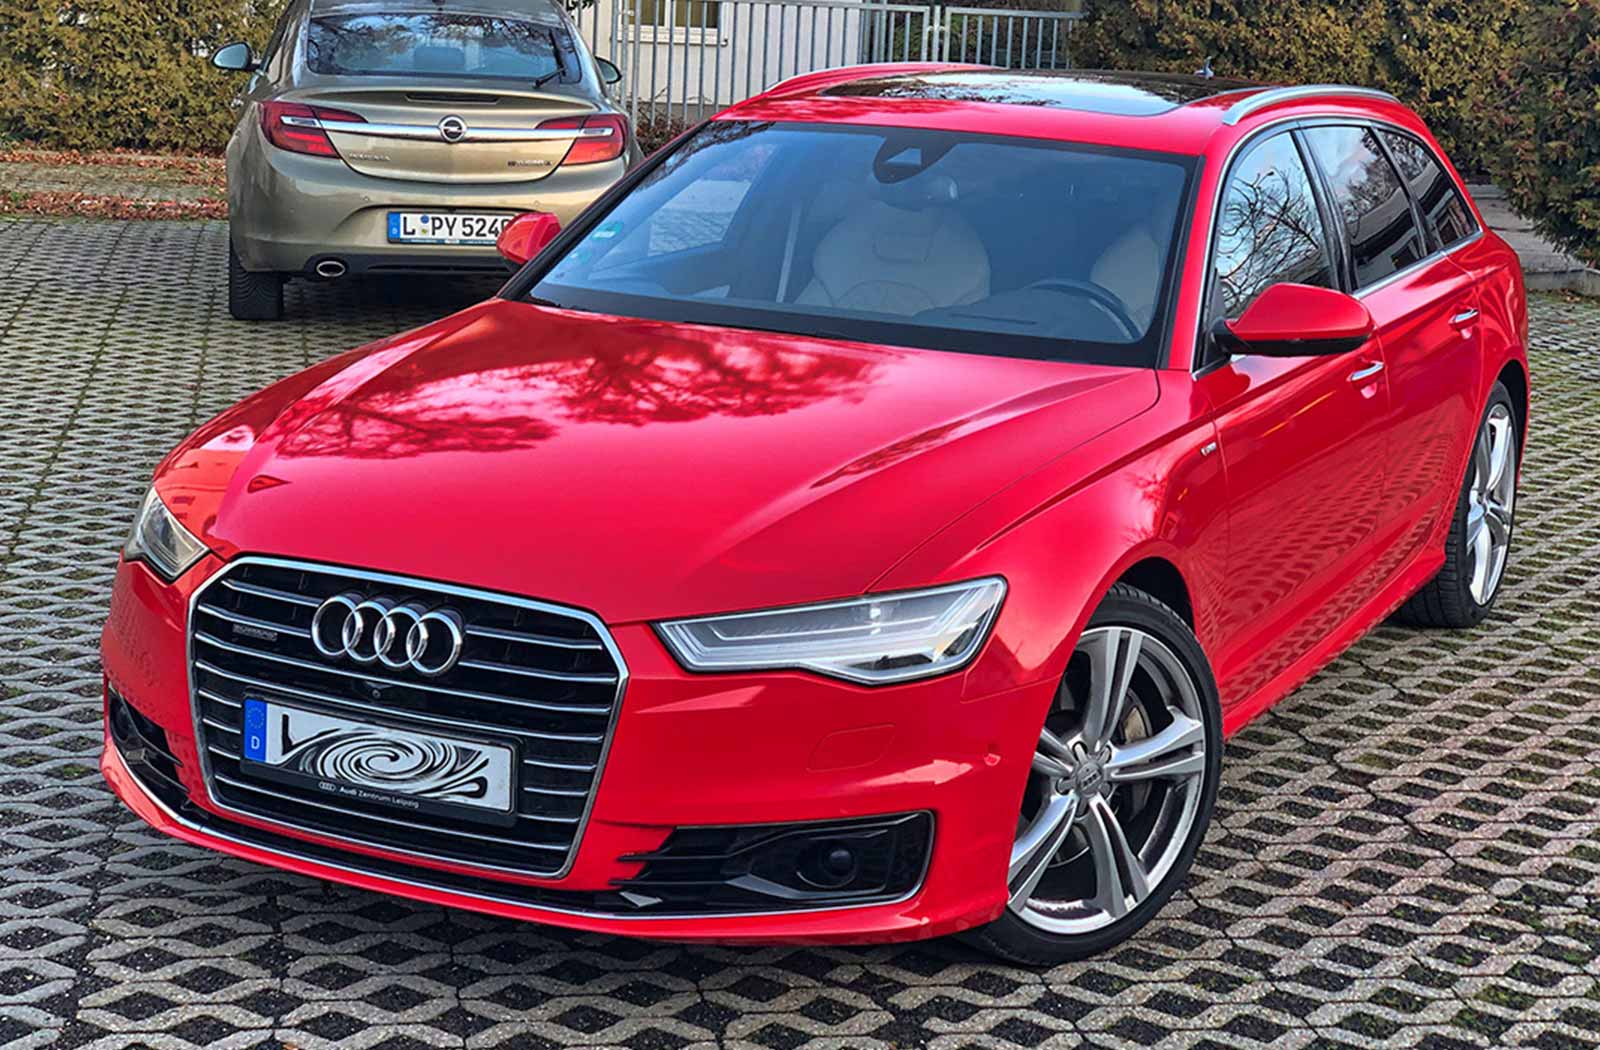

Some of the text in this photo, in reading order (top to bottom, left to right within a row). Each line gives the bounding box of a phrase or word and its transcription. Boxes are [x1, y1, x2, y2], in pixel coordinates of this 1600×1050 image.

[403, 216, 416, 235] L
[431, 216, 457, 236] PY
[250, 735, 260, 749] D
[339, 786, 419, 809] Audi Zentrum Leipzig
